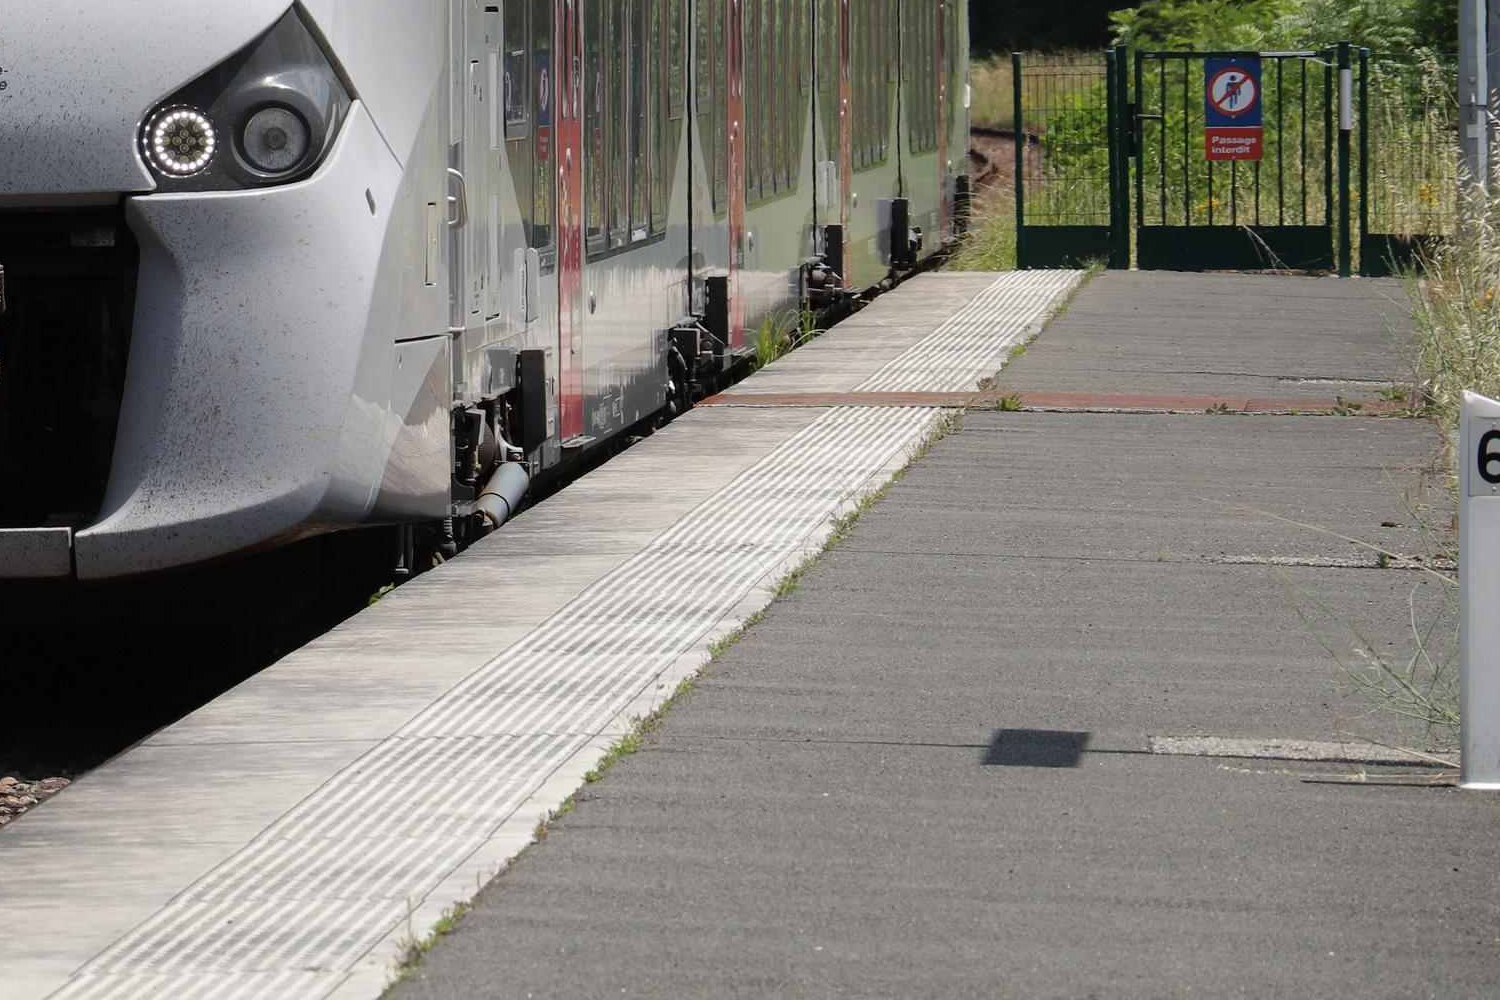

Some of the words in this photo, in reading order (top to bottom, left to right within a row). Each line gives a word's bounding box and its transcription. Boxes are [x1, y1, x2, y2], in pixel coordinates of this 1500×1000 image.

[1212, 135, 1257, 146] Passage
[1211, 146, 1251, 154] interdit
[1477, 429, 1500, 484] 6
